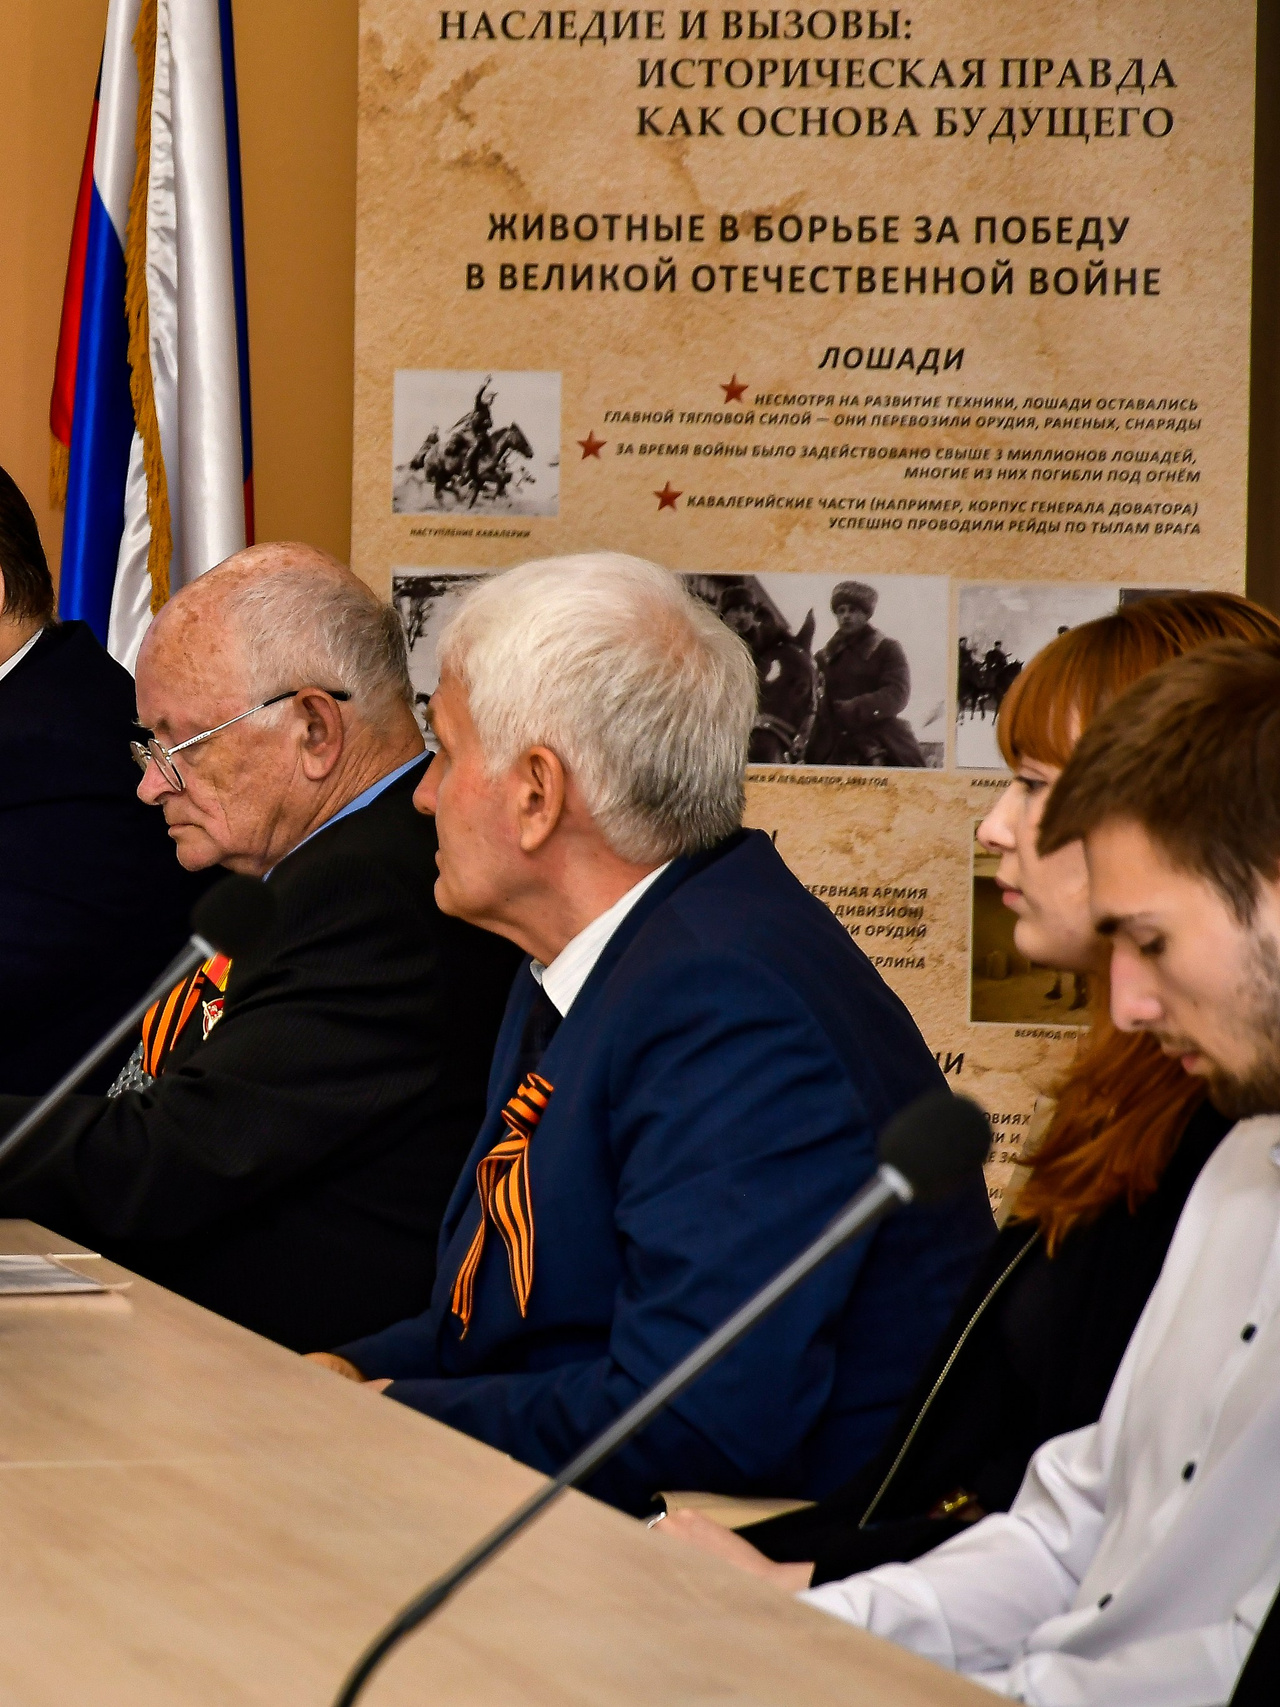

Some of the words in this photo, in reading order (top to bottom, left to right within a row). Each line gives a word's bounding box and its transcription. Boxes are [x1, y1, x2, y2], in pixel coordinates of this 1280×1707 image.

[439, 10, 665, 45] НАСЛЕДИЕ
[678, 11, 708, 40] И
[721, 10, 912, 40] ВЫЗОВЫ:
[637, 57, 986, 89] ИСТОРИЧЕСКАЯ
[998, 57, 1177, 94] ПРАВДА
[636, 106, 723, 136] КАК
[737, 106, 920, 137] ОСНОВА
[933, 106, 1175, 143] БУДУЩЕГО
[487, 213, 705, 242] ЖИВОТНЫЕ
[720, 214, 739, 242] В
[753, 215, 900, 243] БОРЬБЕ
[913, 215, 959, 244] ЗА
[974, 216, 1130, 250] ПОБЕДУ
[465, 262, 485, 291] В
[498, 257, 677, 292] ВЕЛИКОЙ
[691, 259, 1014, 294] ОТЕЧЕСТВЕННОЙ
[1028, 260, 1161, 295] ВОЙНЕ
[818, 346, 965, 375] ЛОШАДИ
[754, 393, 835, 407] НЕСМОТРЯ
[840, 394, 861, 408] НА
[864, 394, 941, 408] РАЗВИТИЕ
[946, 395, 1018, 410] ТЕХНИКИ,
[1022, 396, 1091, 412] ЛОШАДИ
[1097, 397, 1198, 411] ОСТАВАЛИСЬ
[604, 409, 673, 424] ГЛАВНОЙ
[679, 410, 754, 425] ТЯГЛОВОЙ
[759, 411, 811, 426] СИЛОЙ
[834, 413, 866, 427] ОНИ
[871, 413, 970, 427] ПЕРЕВОЗИЛИ
[976, 414, 1039, 428] ОРУДИЯ,
[1044, 415, 1119, 429] РАНЕНЫХ,
[1125, 416, 1201, 430] СНАРЯДЫ
[616, 442, 633, 456] ЗА
[639, 442, 688, 456] ВРЕМЯ
[693, 442, 747, 457] ВОЙНЫ
[752, 444, 795, 458] БЫЛО
[800, 445, 930, 460] ЗАДЕЙСТВОВАНО
[936, 446, 990, 460] СВЫШЕ
[995, 446, 1002, 460] 3
[1008, 447, 1106, 461] МИЛЛИОНОВ
[1112, 448, 1197, 463] ЛОШАДЕЙ,
[904, 466, 968, 480] МНОГИЕ
[974, 467, 992, 481] ИЗ
[997, 467, 1026, 481] НИХ
[1032, 468, 1102, 482] ПОГИБЛИ
[1107, 468, 1141, 482] ПОД
[1146, 469, 1200, 483] ОГНЁМ
[687, 494, 813, 509] КАВАЛЕРИЙСКИЕ
[819, 496, 866, 510] ЧАСТИ
[870, 497, 963, 511] (НАПРИМЕР,
[969, 498, 1026, 512] КОРПУС
[1031, 499, 1104, 513] ГЕНЕРАЛА
[1109, 500, 1198, 514] ДОВАТОРА)
[829, 517, 902, 531] УСПЕШНО
[907, 518, 1004, 532] ПРОВОДИЛИ
[1009, 518, 1060, 533] РЕЙДЫ
[1065, 520, 1086, 534] ПО
[1092, 520, 1149, 534] ТЫЛАМ
[1154, 521, 1200, 535] ВРАГА
[873, 887, 928, 899] АРМИЯ
[865, 924, 927, 939] ОРУДИЙ
